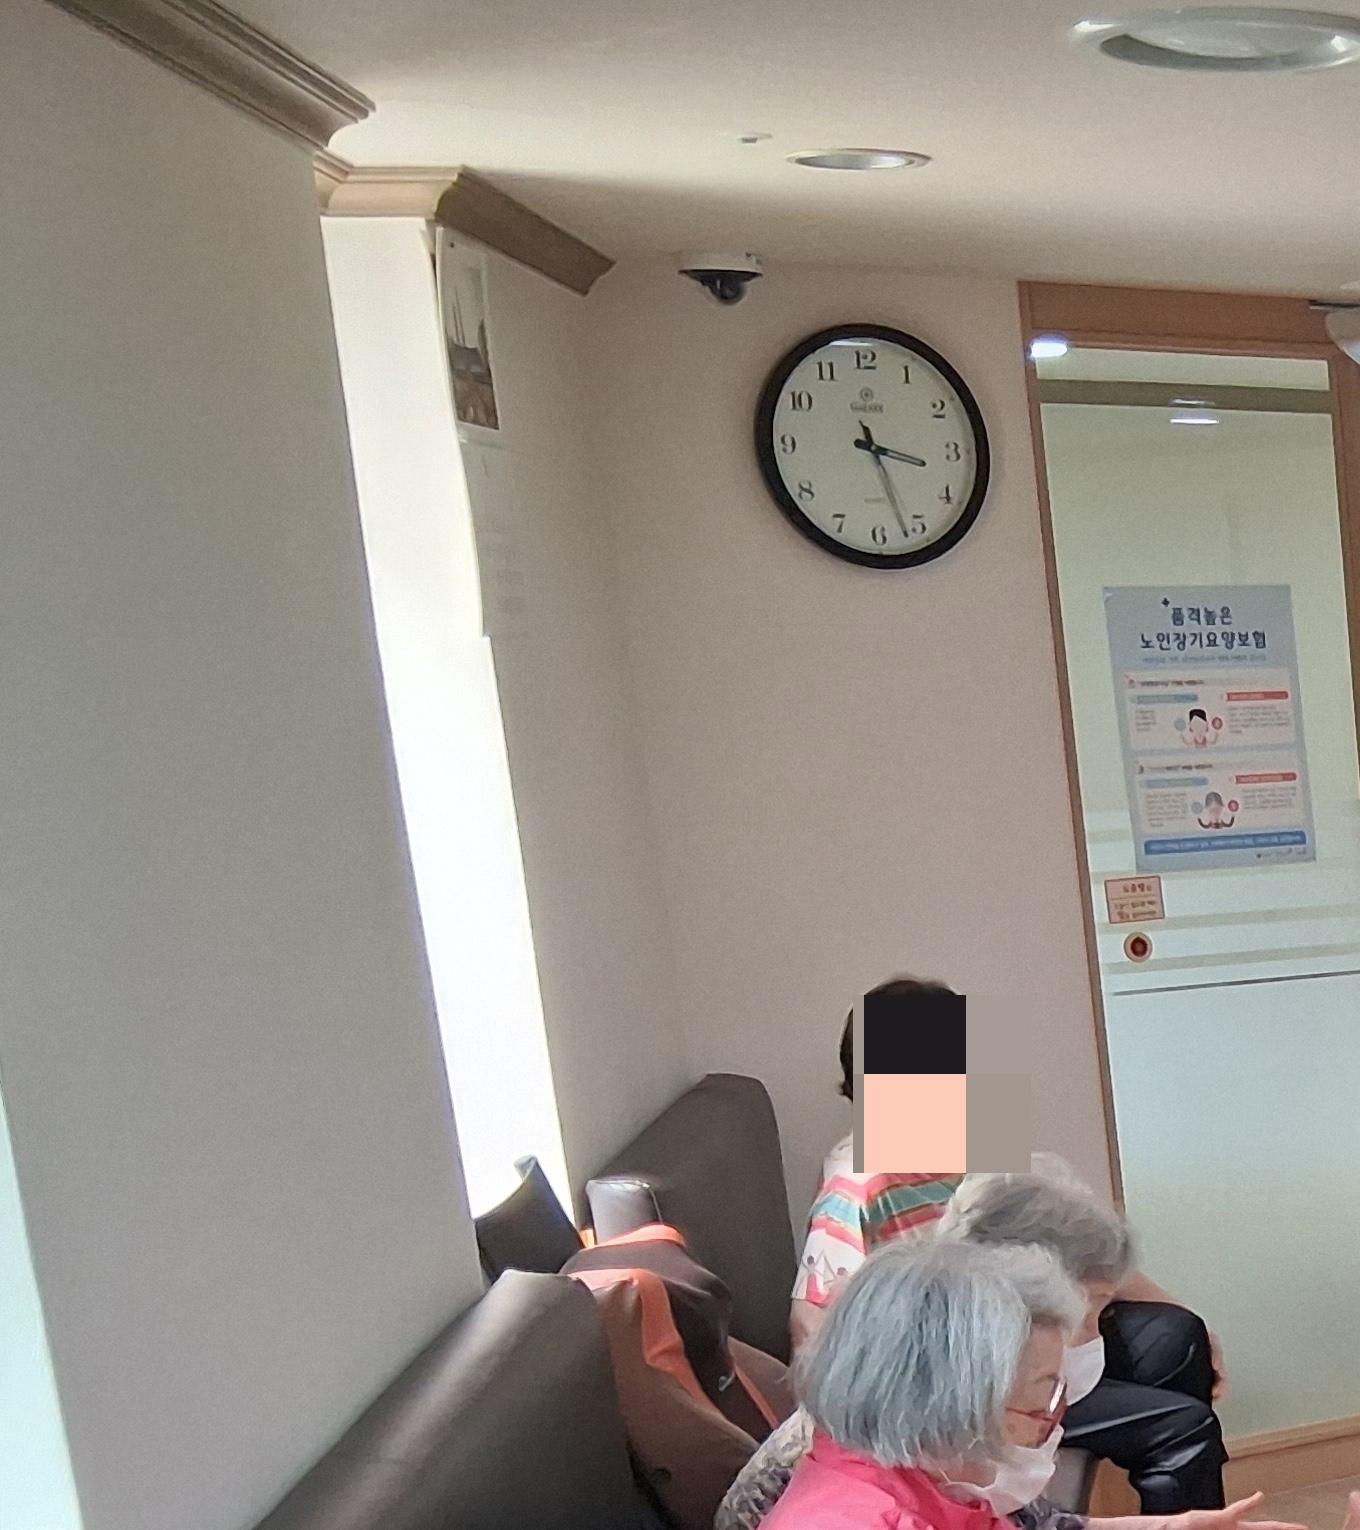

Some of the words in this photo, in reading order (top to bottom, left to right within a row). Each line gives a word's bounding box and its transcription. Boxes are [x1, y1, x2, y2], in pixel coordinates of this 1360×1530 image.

[854, 350, 877, 370] 12
[816, 361, 837, 382] 11
[903, 365, 912, 385] 1
[790, 391, 813, 412] 10
[931, 399, 946, 419] 2
[780, 434, 796, 455] 9
[945, 442, 961, 462] 3
[798, 481, 815, 502] 8
[938, 484, 953, 505] 4
[832, 513, 846, 533] 7
[911, 514, 927, 535] 5
[871, 526, 887, 545] 6
[1171, 606, 1233, 626] 품격높은
[1140, 630, 1267, 650] 노인장기요양보험
